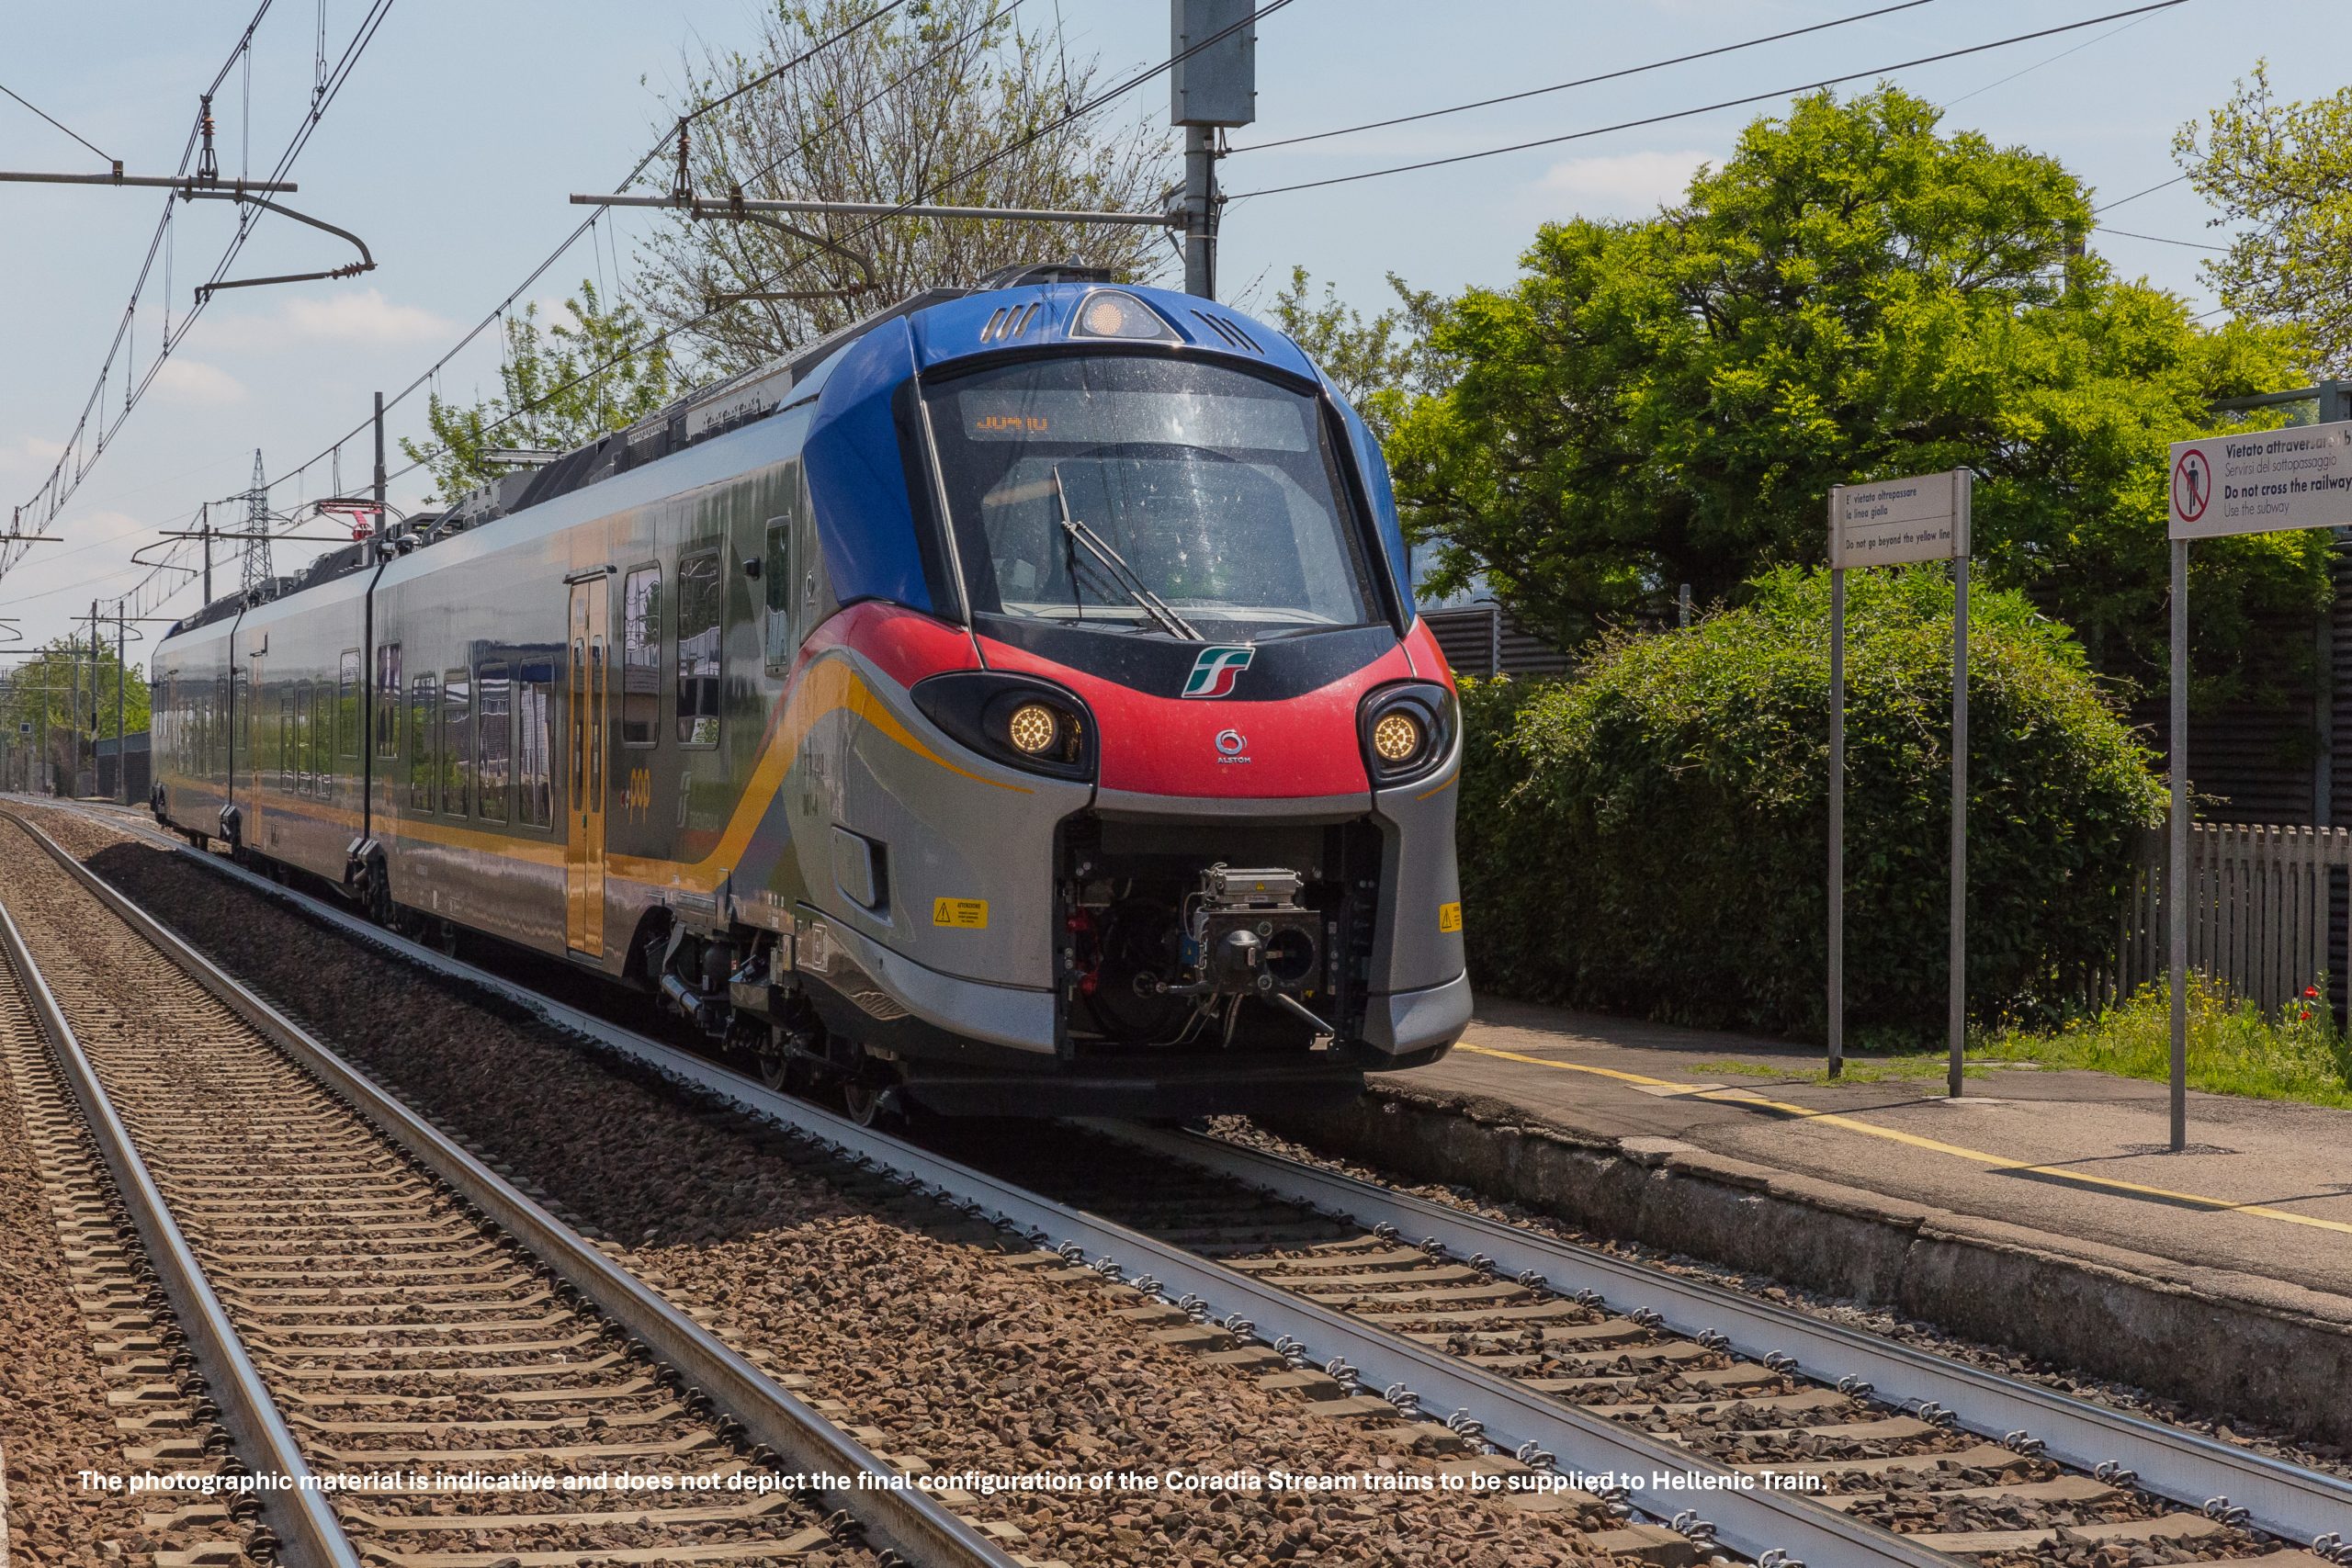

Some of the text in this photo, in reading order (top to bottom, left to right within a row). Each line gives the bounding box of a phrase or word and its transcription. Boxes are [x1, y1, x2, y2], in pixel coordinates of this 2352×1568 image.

[2226, 443, 2264, 458] Vietato
[2225, 453, 2337, 478] Servirsi del sottopassaggio
[1854, 492, 1875, 504] vietato
[1878, 488, 1917, 502] oltrepassare
[2224, 474, 2352, 500] Do not cross the railway
[1846, 504, 1888, 520] la linea gialla
[2223, 499, 2290, 518] Use the subway
[1846, 528, 1951, 550] Do not go beyond the yellow line
